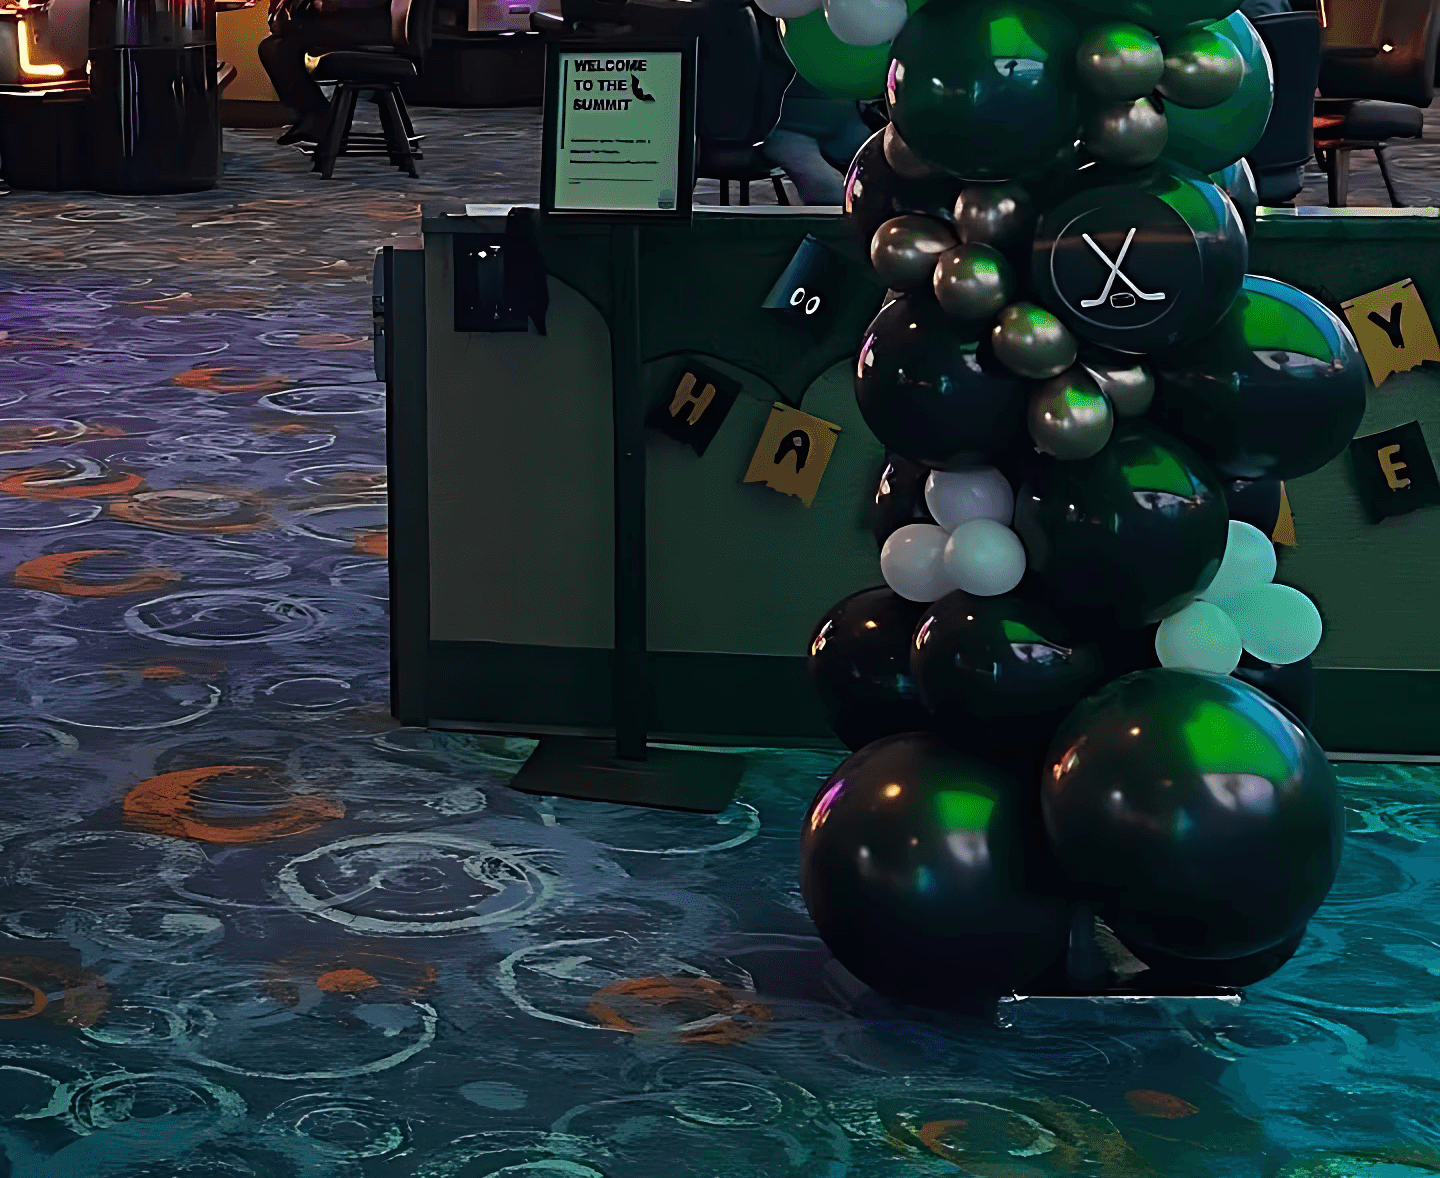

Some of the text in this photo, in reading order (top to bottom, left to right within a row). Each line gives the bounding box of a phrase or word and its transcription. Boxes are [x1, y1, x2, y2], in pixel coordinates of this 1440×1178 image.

[573, 59, 648, 73] WELCOME
[573, 79, 628, 92] TO THE
[573, 98, 633, 111] SUMMIT
[1366, 302, 1406, 349] Y
[668, 371, 716, 426] H
[1377, 443, 1412, 493] E
